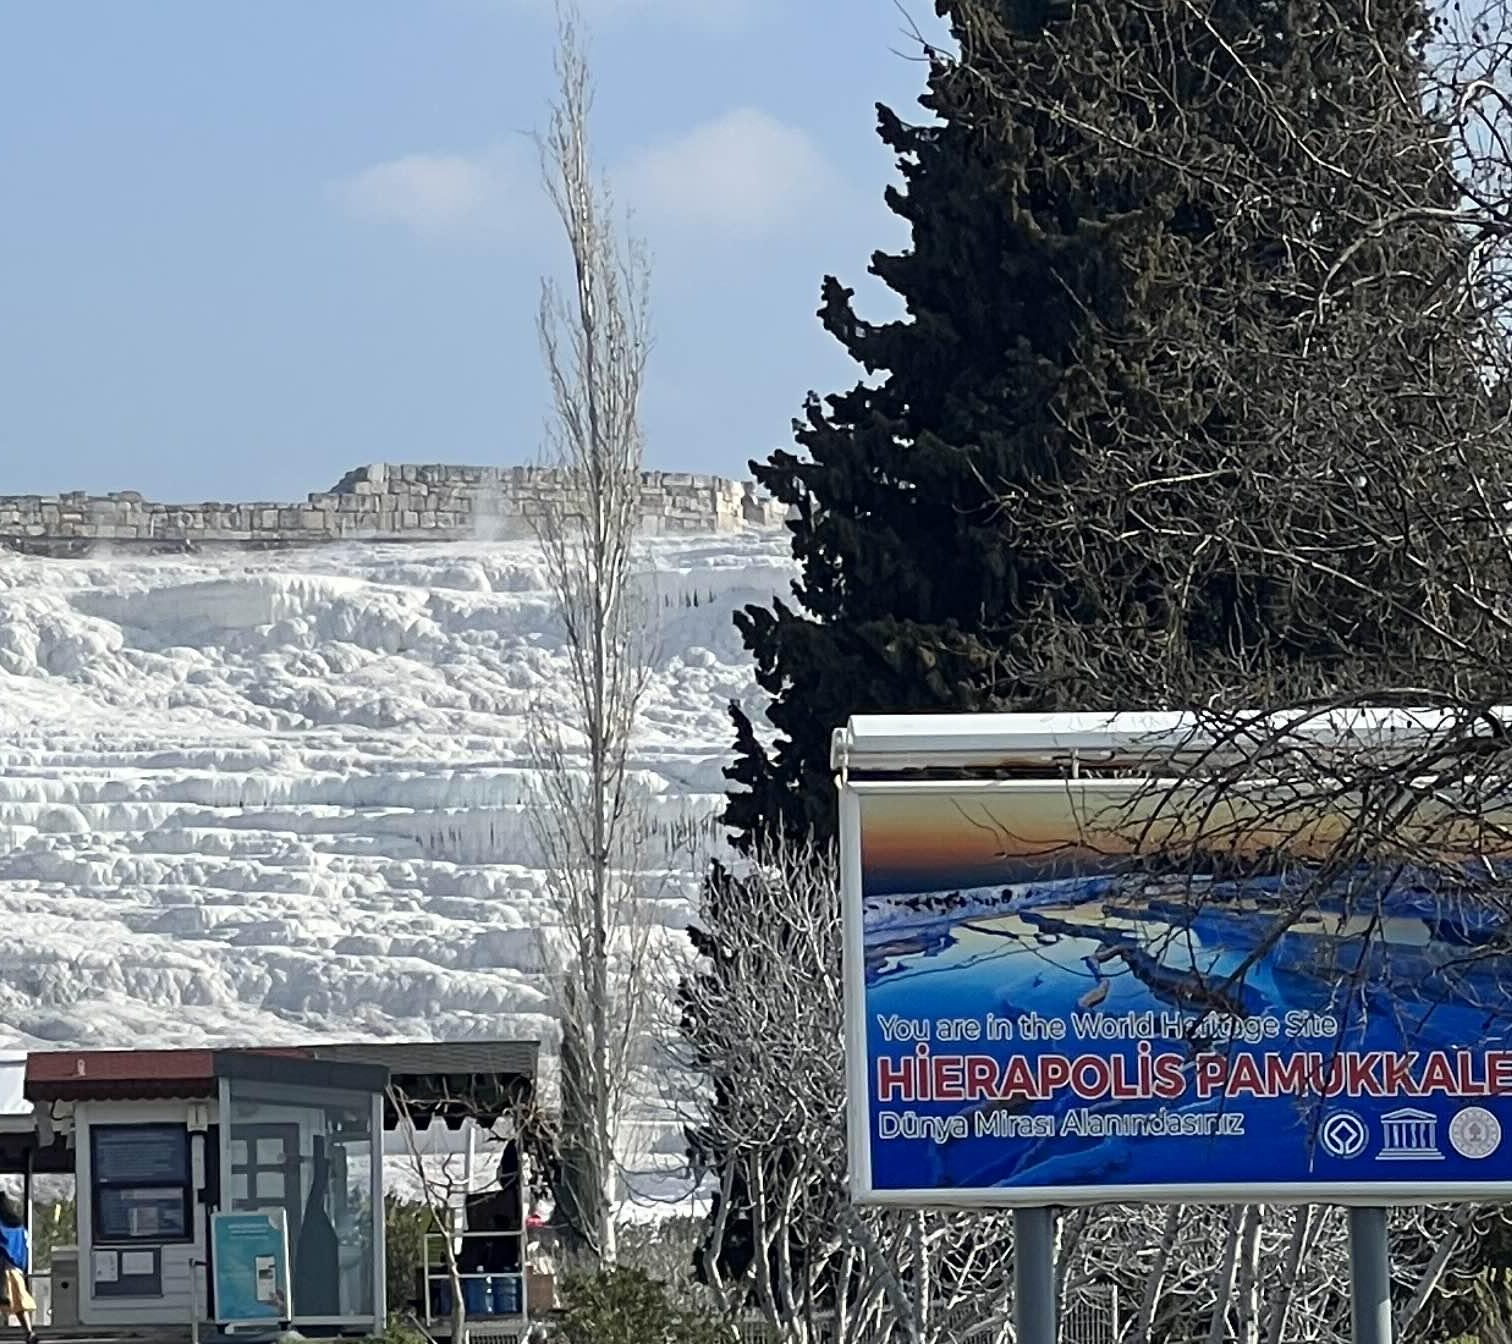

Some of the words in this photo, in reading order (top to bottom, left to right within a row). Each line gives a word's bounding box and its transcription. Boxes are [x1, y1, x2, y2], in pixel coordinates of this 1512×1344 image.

[877, 1014, 930, 1041] You
[936, 1016, 981, 1040] are
[987, 1013, 1013, 1040] in
[1017, 1011, 1066, 1039] the
[1071, 1011, 1155, 1040] World
[1285, 1009, 1338, 1039] Site
[877, 1040, 1187, 1101] HİERAPOLİS
[1196, 1051, 1512, 1099] PAMUKKALE
[878, 1111, 968, 1144] Dünya
[974, 1109, 1055, 1137] Mirası
